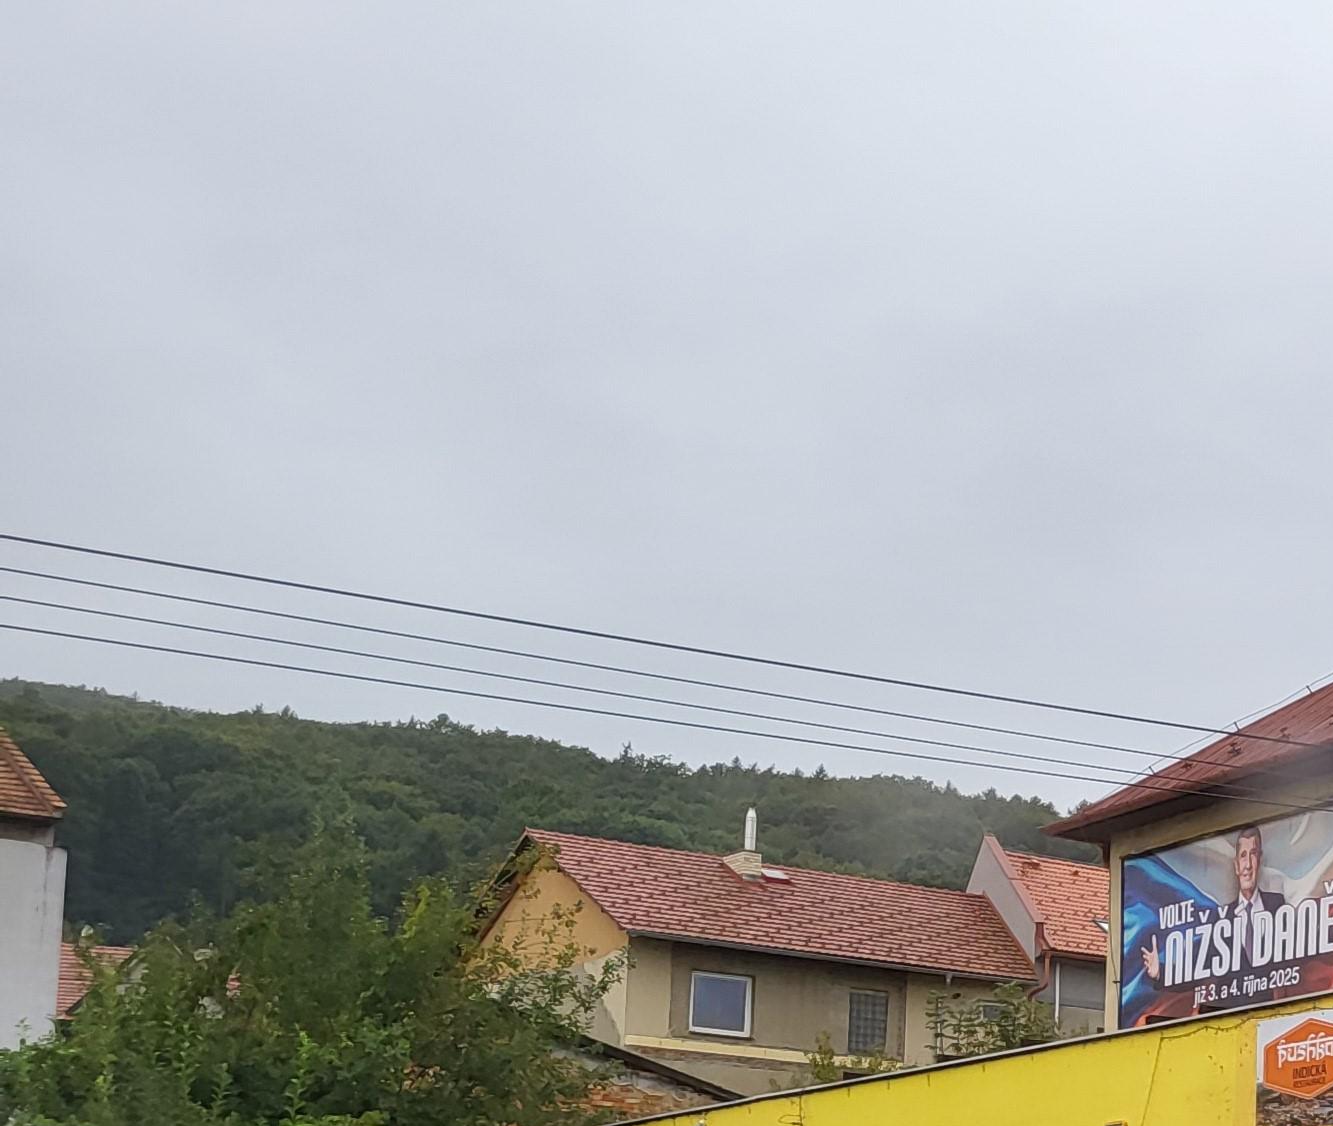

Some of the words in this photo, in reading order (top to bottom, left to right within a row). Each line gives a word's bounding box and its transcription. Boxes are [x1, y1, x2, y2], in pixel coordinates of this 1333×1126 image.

[1159, 899, 1195, 930] VOLTE
[1164, 900, 1247, 987] NIŽŠÍ
[1193, 985, 1207, 1008] již
[1208, 983, 1219, 1001] 3.
[1221, 986, 1228, 997] a
[1230, 980, 1241, 996] 4.
[1243, 974, 1267, 996] října
[1269, 967, 1300, 988] 2025
